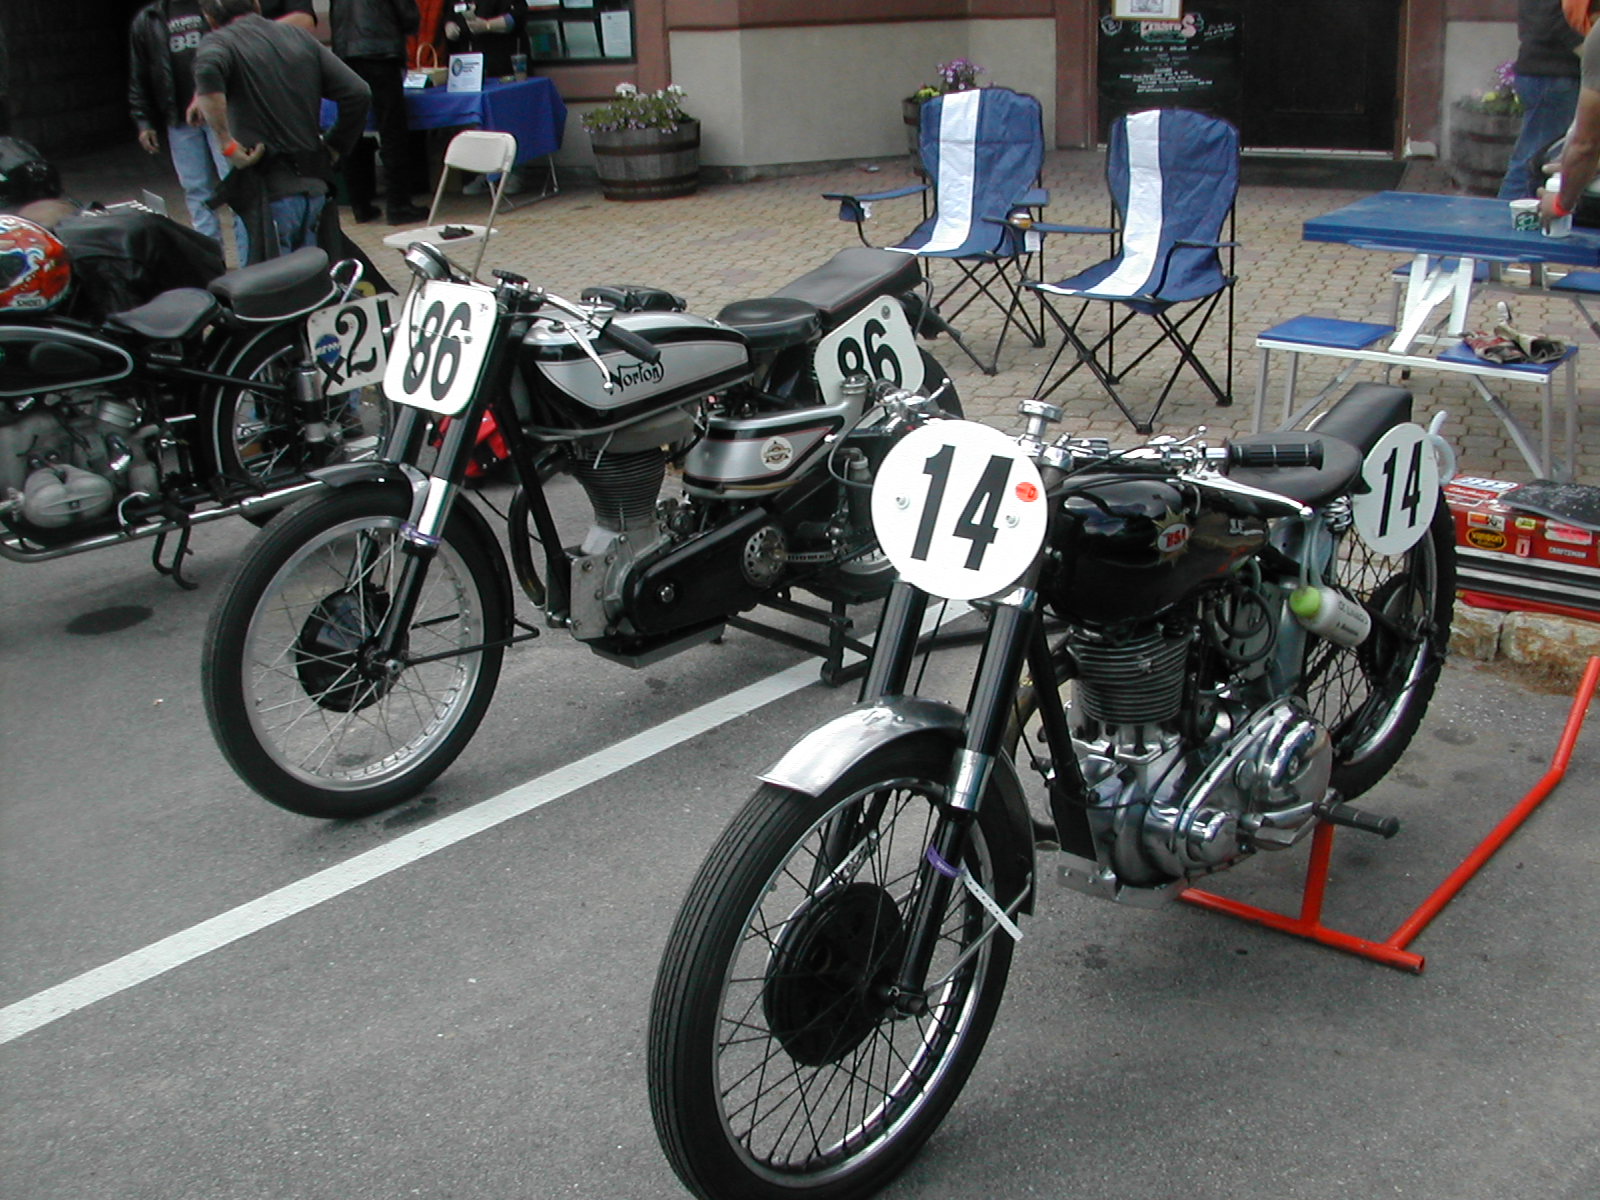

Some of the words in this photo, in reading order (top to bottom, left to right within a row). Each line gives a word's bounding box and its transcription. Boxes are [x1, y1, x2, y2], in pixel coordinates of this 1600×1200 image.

[170, 32, 201, 52] 88
[403, 300, 471, 401] 86
[602, 362, 664, 394] Norton
[838, 318, 903, 397] 86
[911, 444, 1015, 571] 14
[1378, 440, 1423, 538] 14
